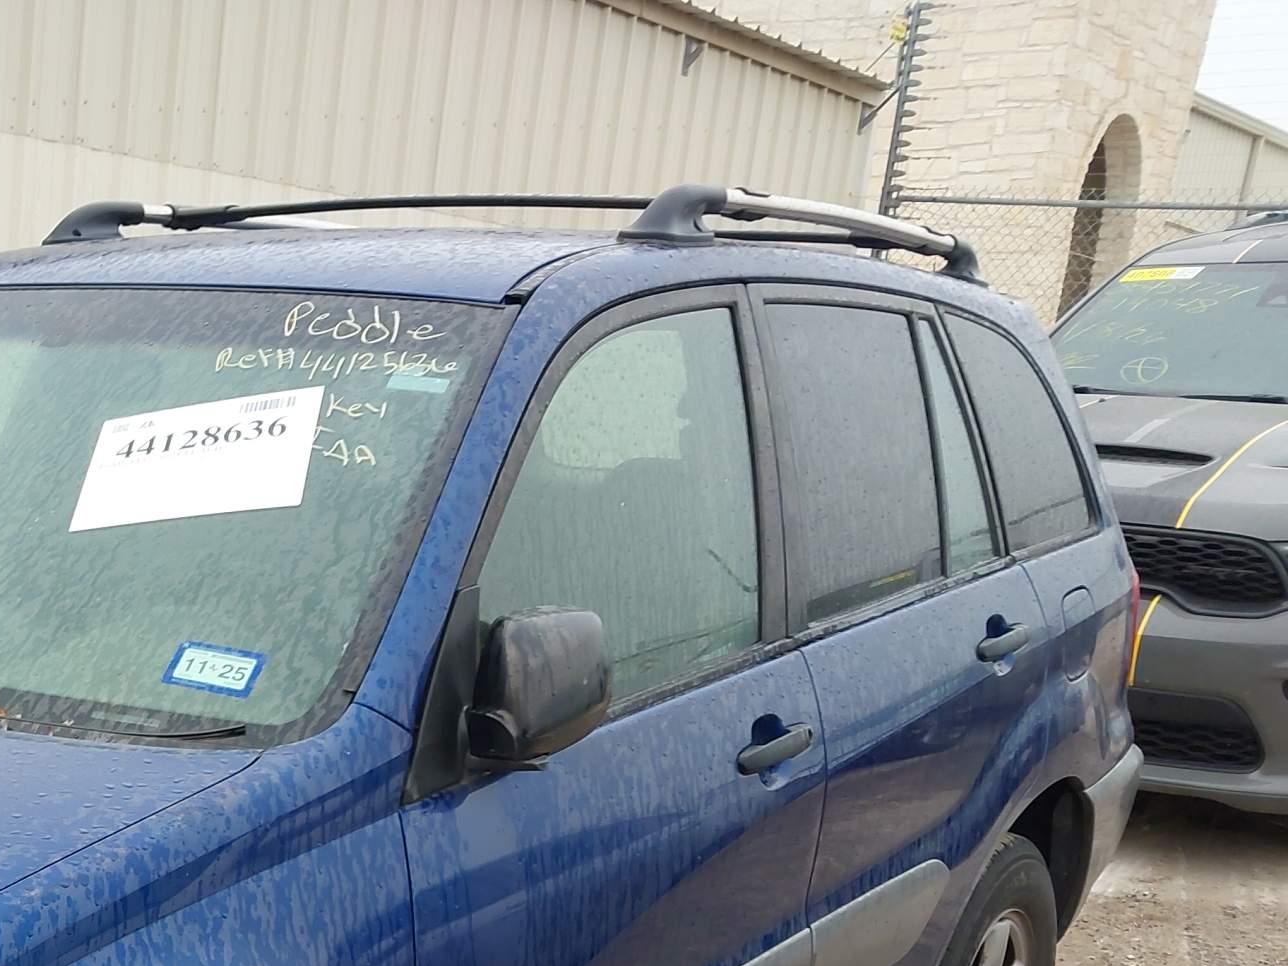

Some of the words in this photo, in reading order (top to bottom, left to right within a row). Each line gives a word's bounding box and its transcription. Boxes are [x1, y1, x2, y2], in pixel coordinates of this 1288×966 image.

[116, 416, 288, 458] 44128636
[184, 658, 209, 675] 11
[218, 664, 249, 682] 25
